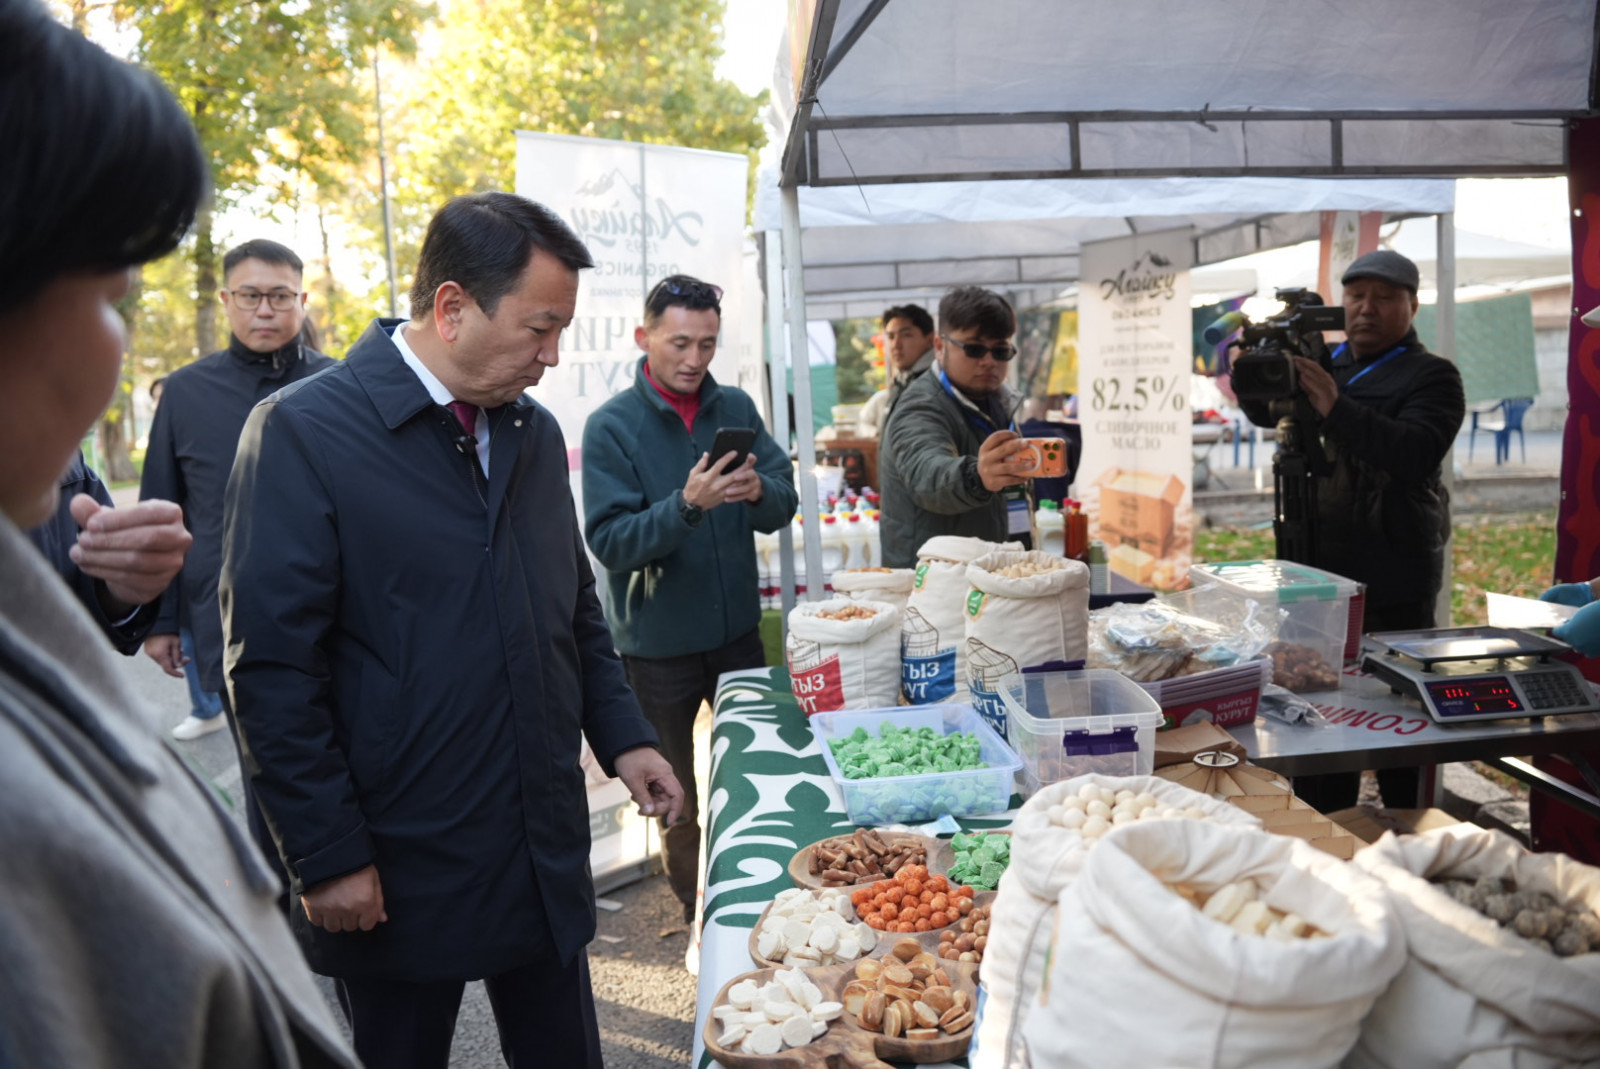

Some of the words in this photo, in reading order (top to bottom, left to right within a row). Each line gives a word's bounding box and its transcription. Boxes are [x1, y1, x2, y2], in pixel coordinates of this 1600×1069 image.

[1091, 374, 1185, 417] 82,5%
[1215, 706, 1251, 723] КУРУТ
[1311, 703, 1429, 736] COMM
